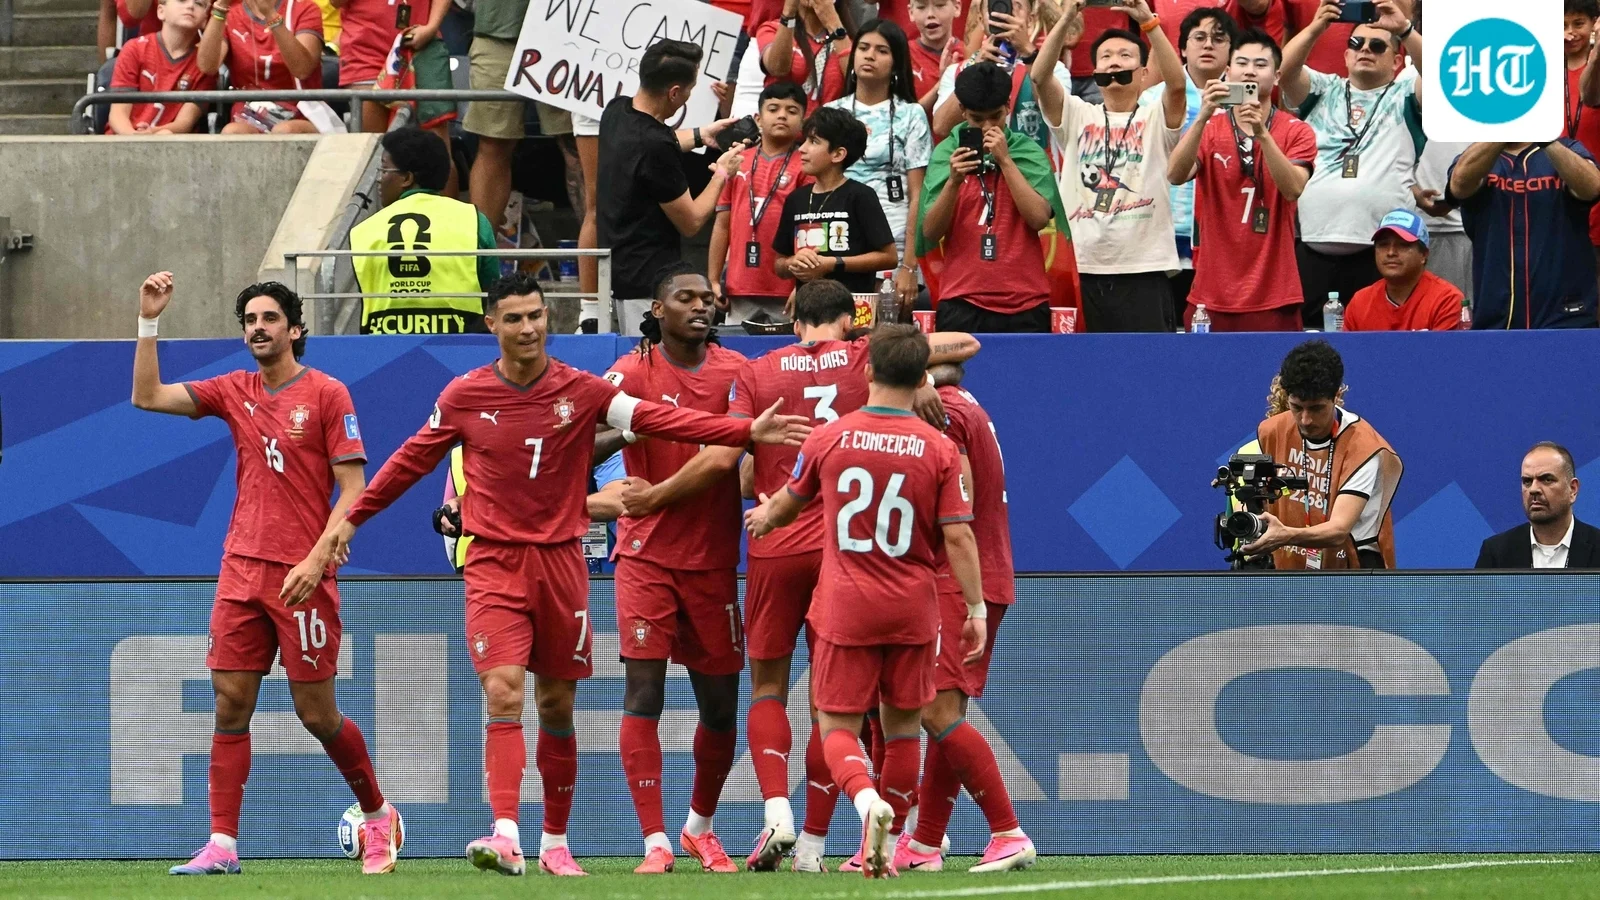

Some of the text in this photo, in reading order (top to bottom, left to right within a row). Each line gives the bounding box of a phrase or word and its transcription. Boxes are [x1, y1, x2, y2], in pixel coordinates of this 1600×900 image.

[545, 0, 737, 81] WE CAME
[259, 55, 273, 80] 7
[591, 48, 640, 76] FOR
[1240, 187, 1256, 224] 7
[399, 263, 420, 272] FIFA
[390, 280, 431, 288] WORLD CUP
[853, 312, 873, 326] ORN
[819, 349, 849, 370] DIAS
[803, 383, 840, 428] 3
[524, 437, 544, 480] 7
[852, 430, 925, 458] CONCEIÇÃO
[836, 466, 915, 558] 26
[292, 608, 327, 652] 16
[574, 609, 588, 652] 7
